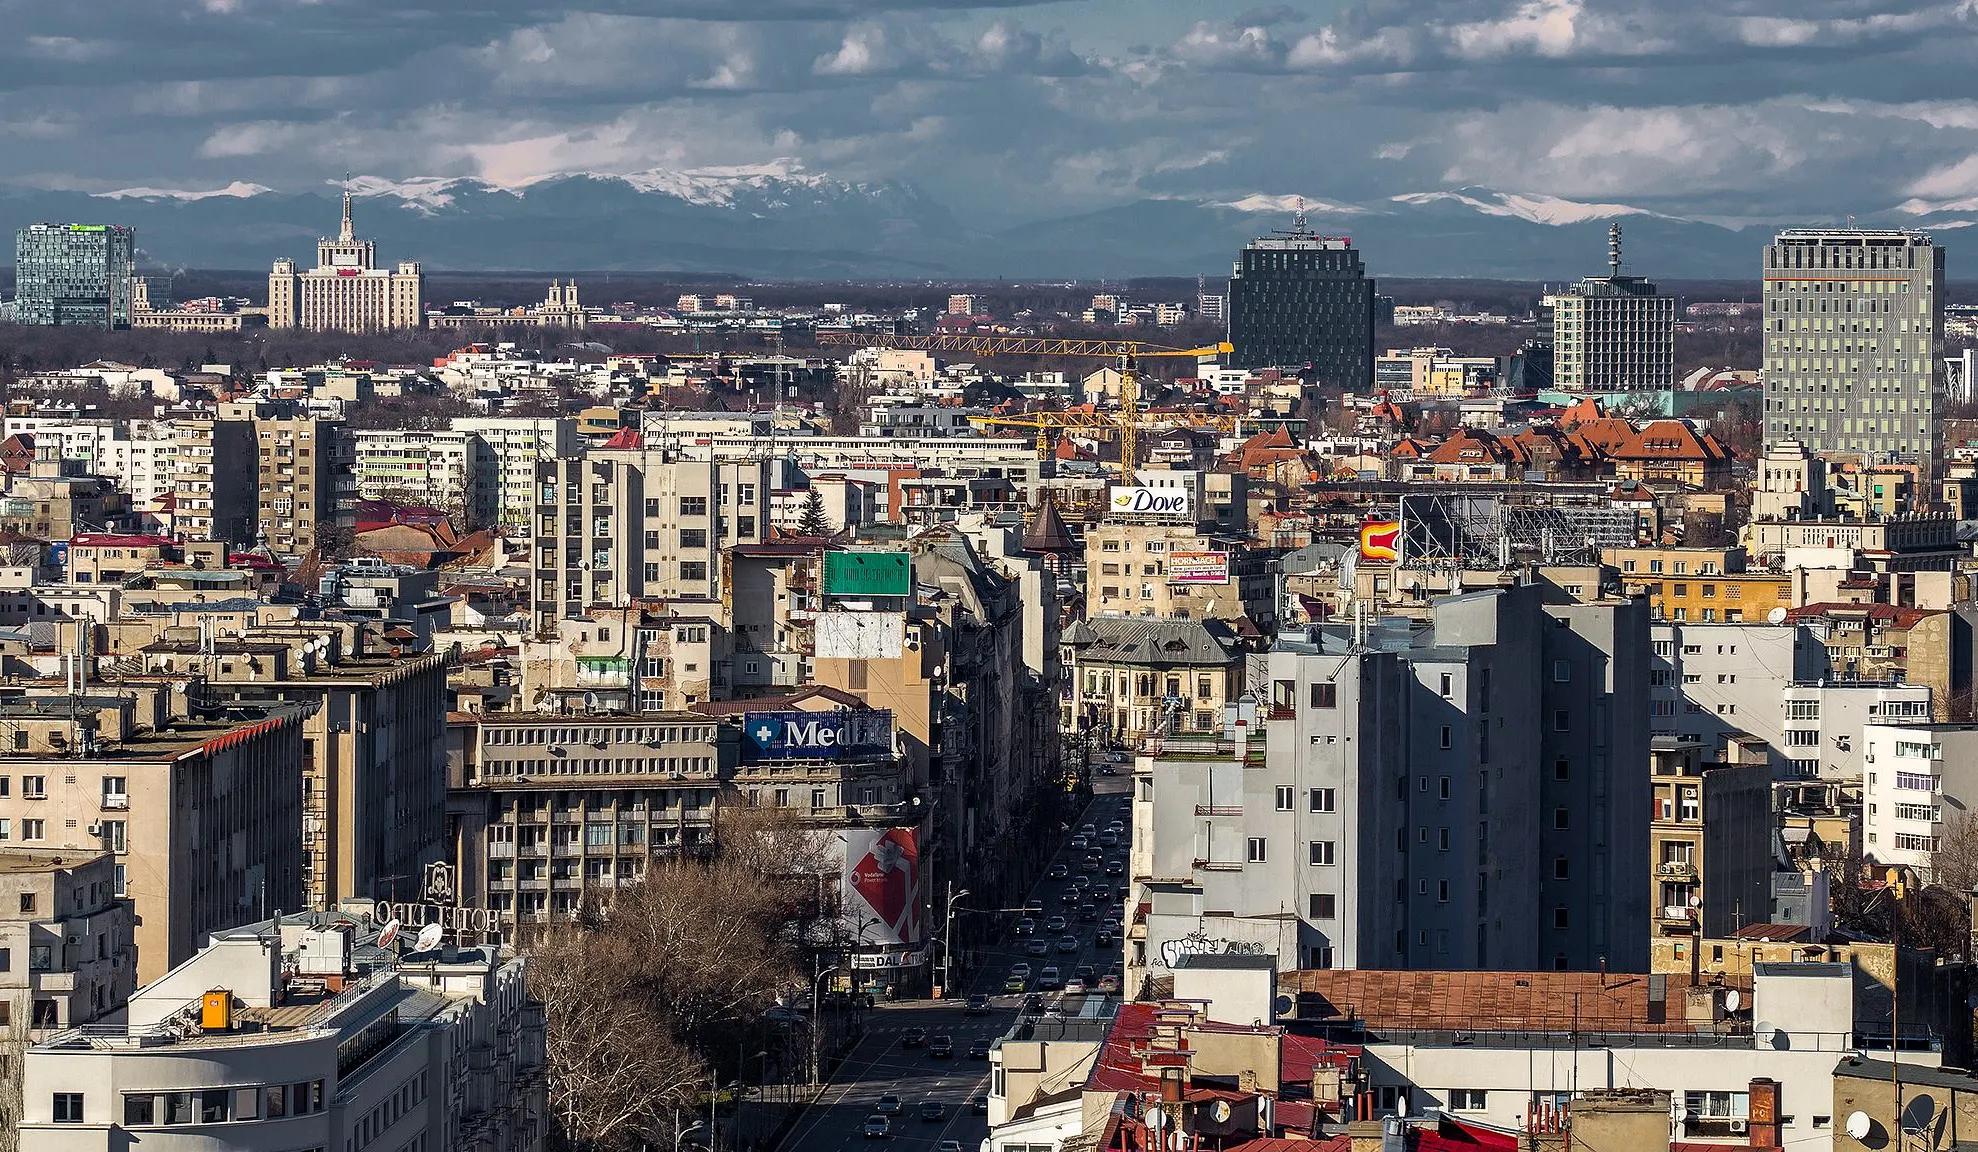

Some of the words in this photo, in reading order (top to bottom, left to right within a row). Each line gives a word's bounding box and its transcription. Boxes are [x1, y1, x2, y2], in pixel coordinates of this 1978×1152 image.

[1134, 489, 1184, 511] Dove
[1171, 556, 1216, 565] HORNBACH
[784, 718, 890, 747] MedLife
[877, 957, 899, 966] DAL
